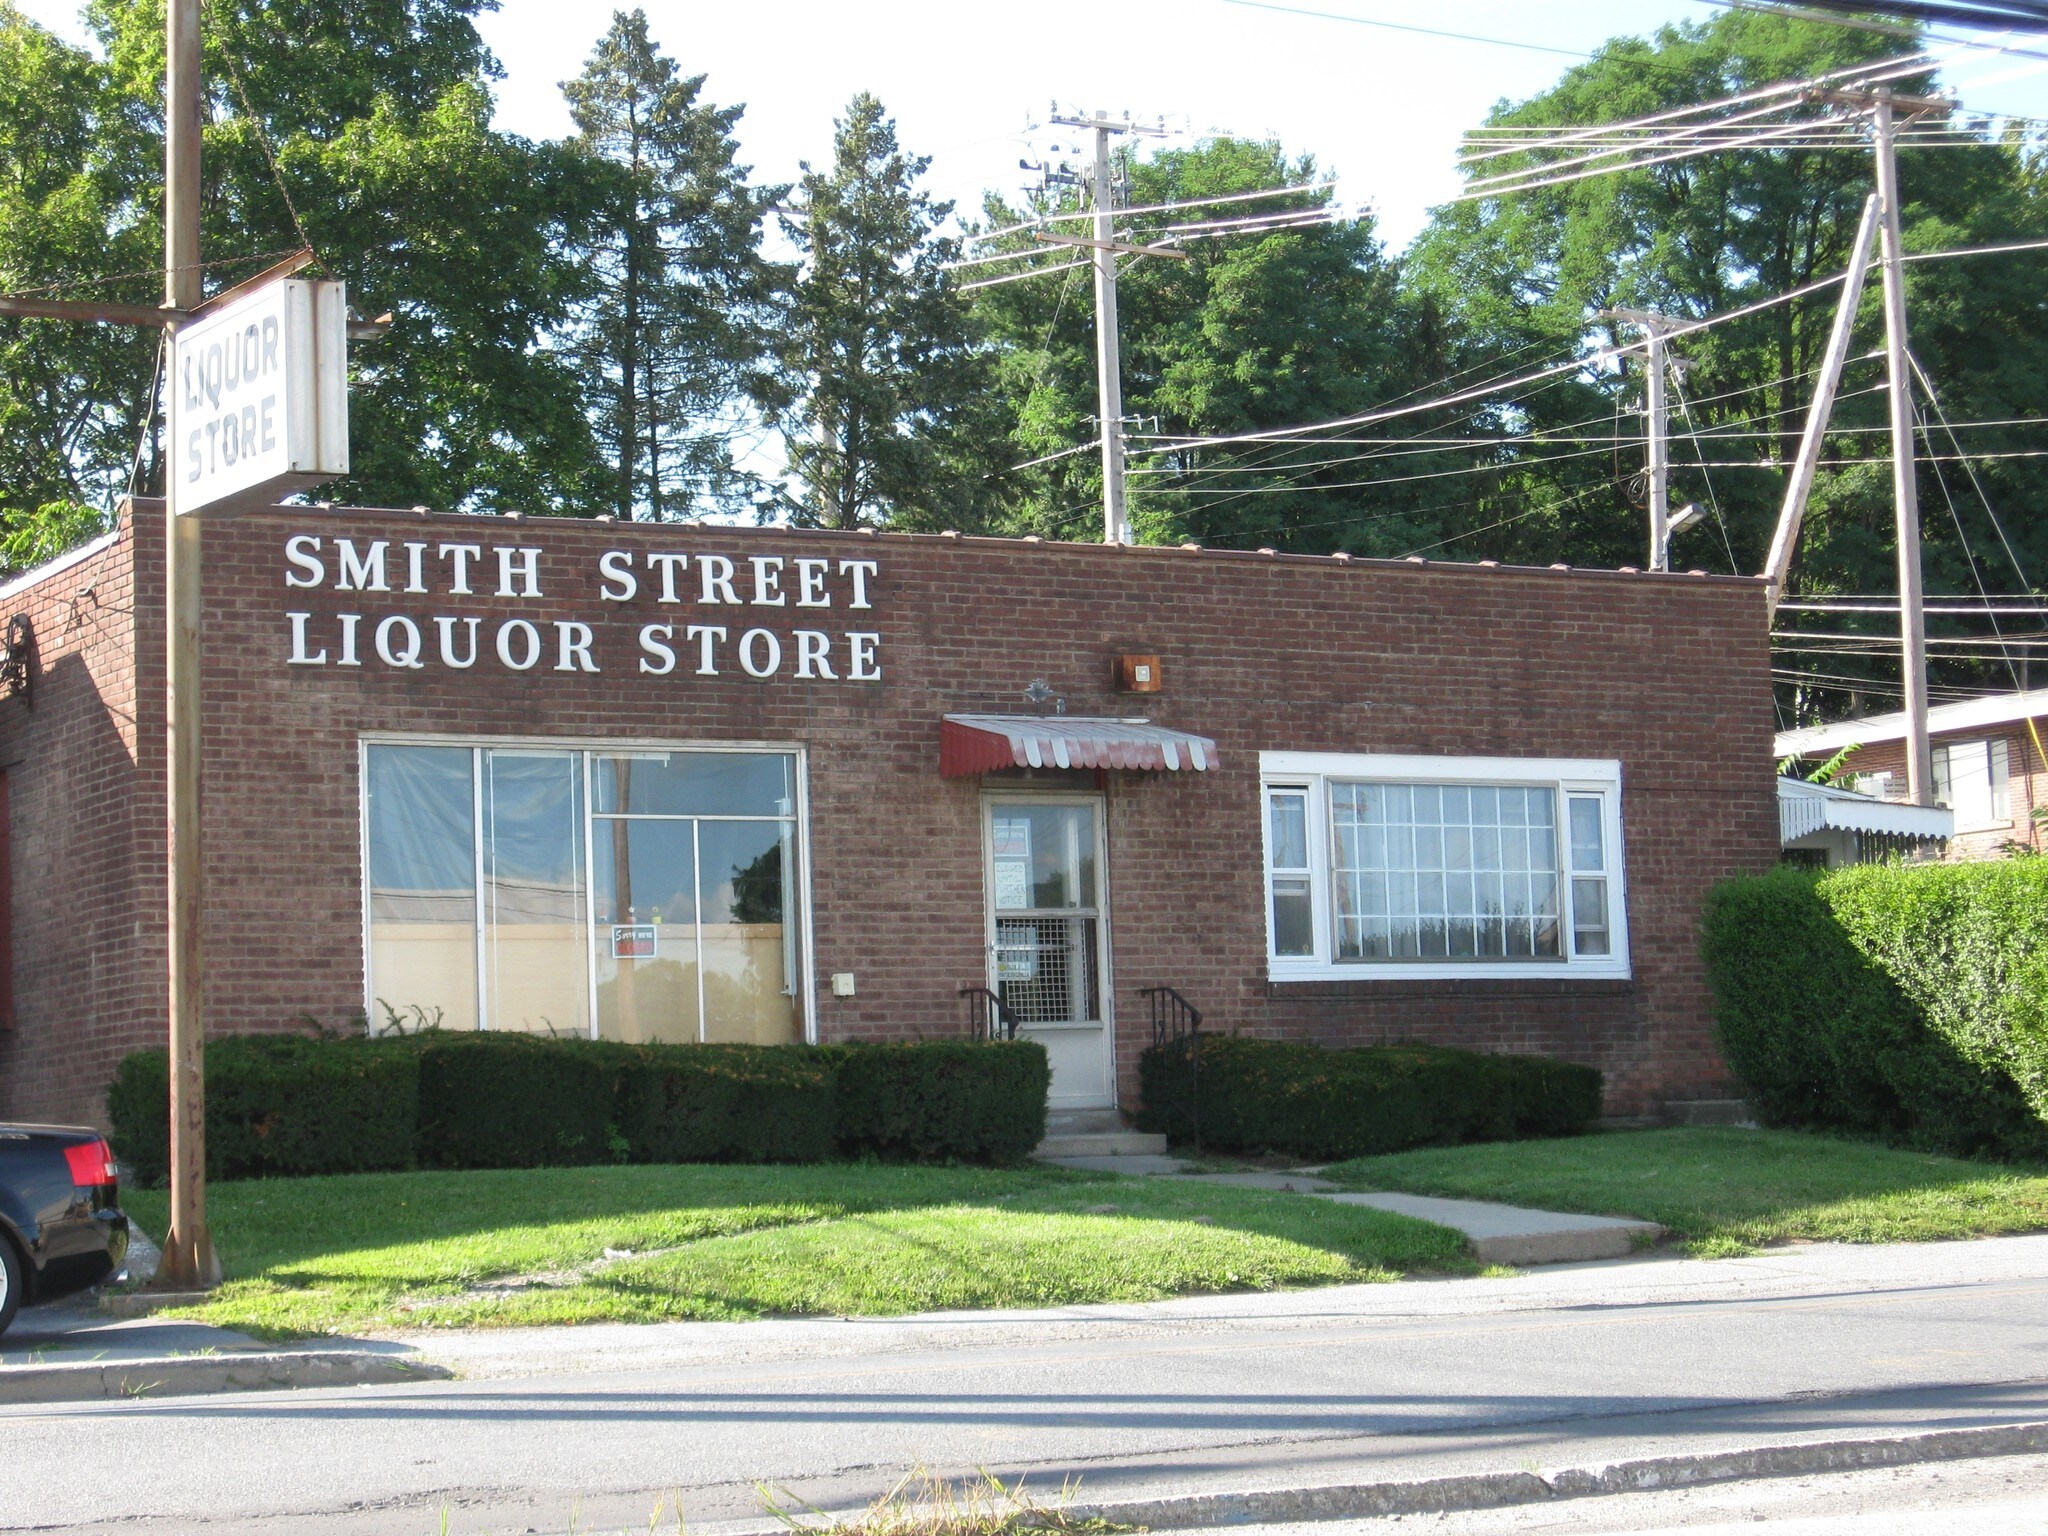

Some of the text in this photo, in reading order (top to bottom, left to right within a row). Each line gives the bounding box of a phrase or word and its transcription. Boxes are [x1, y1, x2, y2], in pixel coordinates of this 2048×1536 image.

[184, 314, 279, 413] LIQUOR
[188, 394, 276, 483] STORE
[285, 535, 879, 609] SMITH STREET
[285, 612, 882, 682] LIQUOR STORE
[616, 929, 636, 941] Sorry
